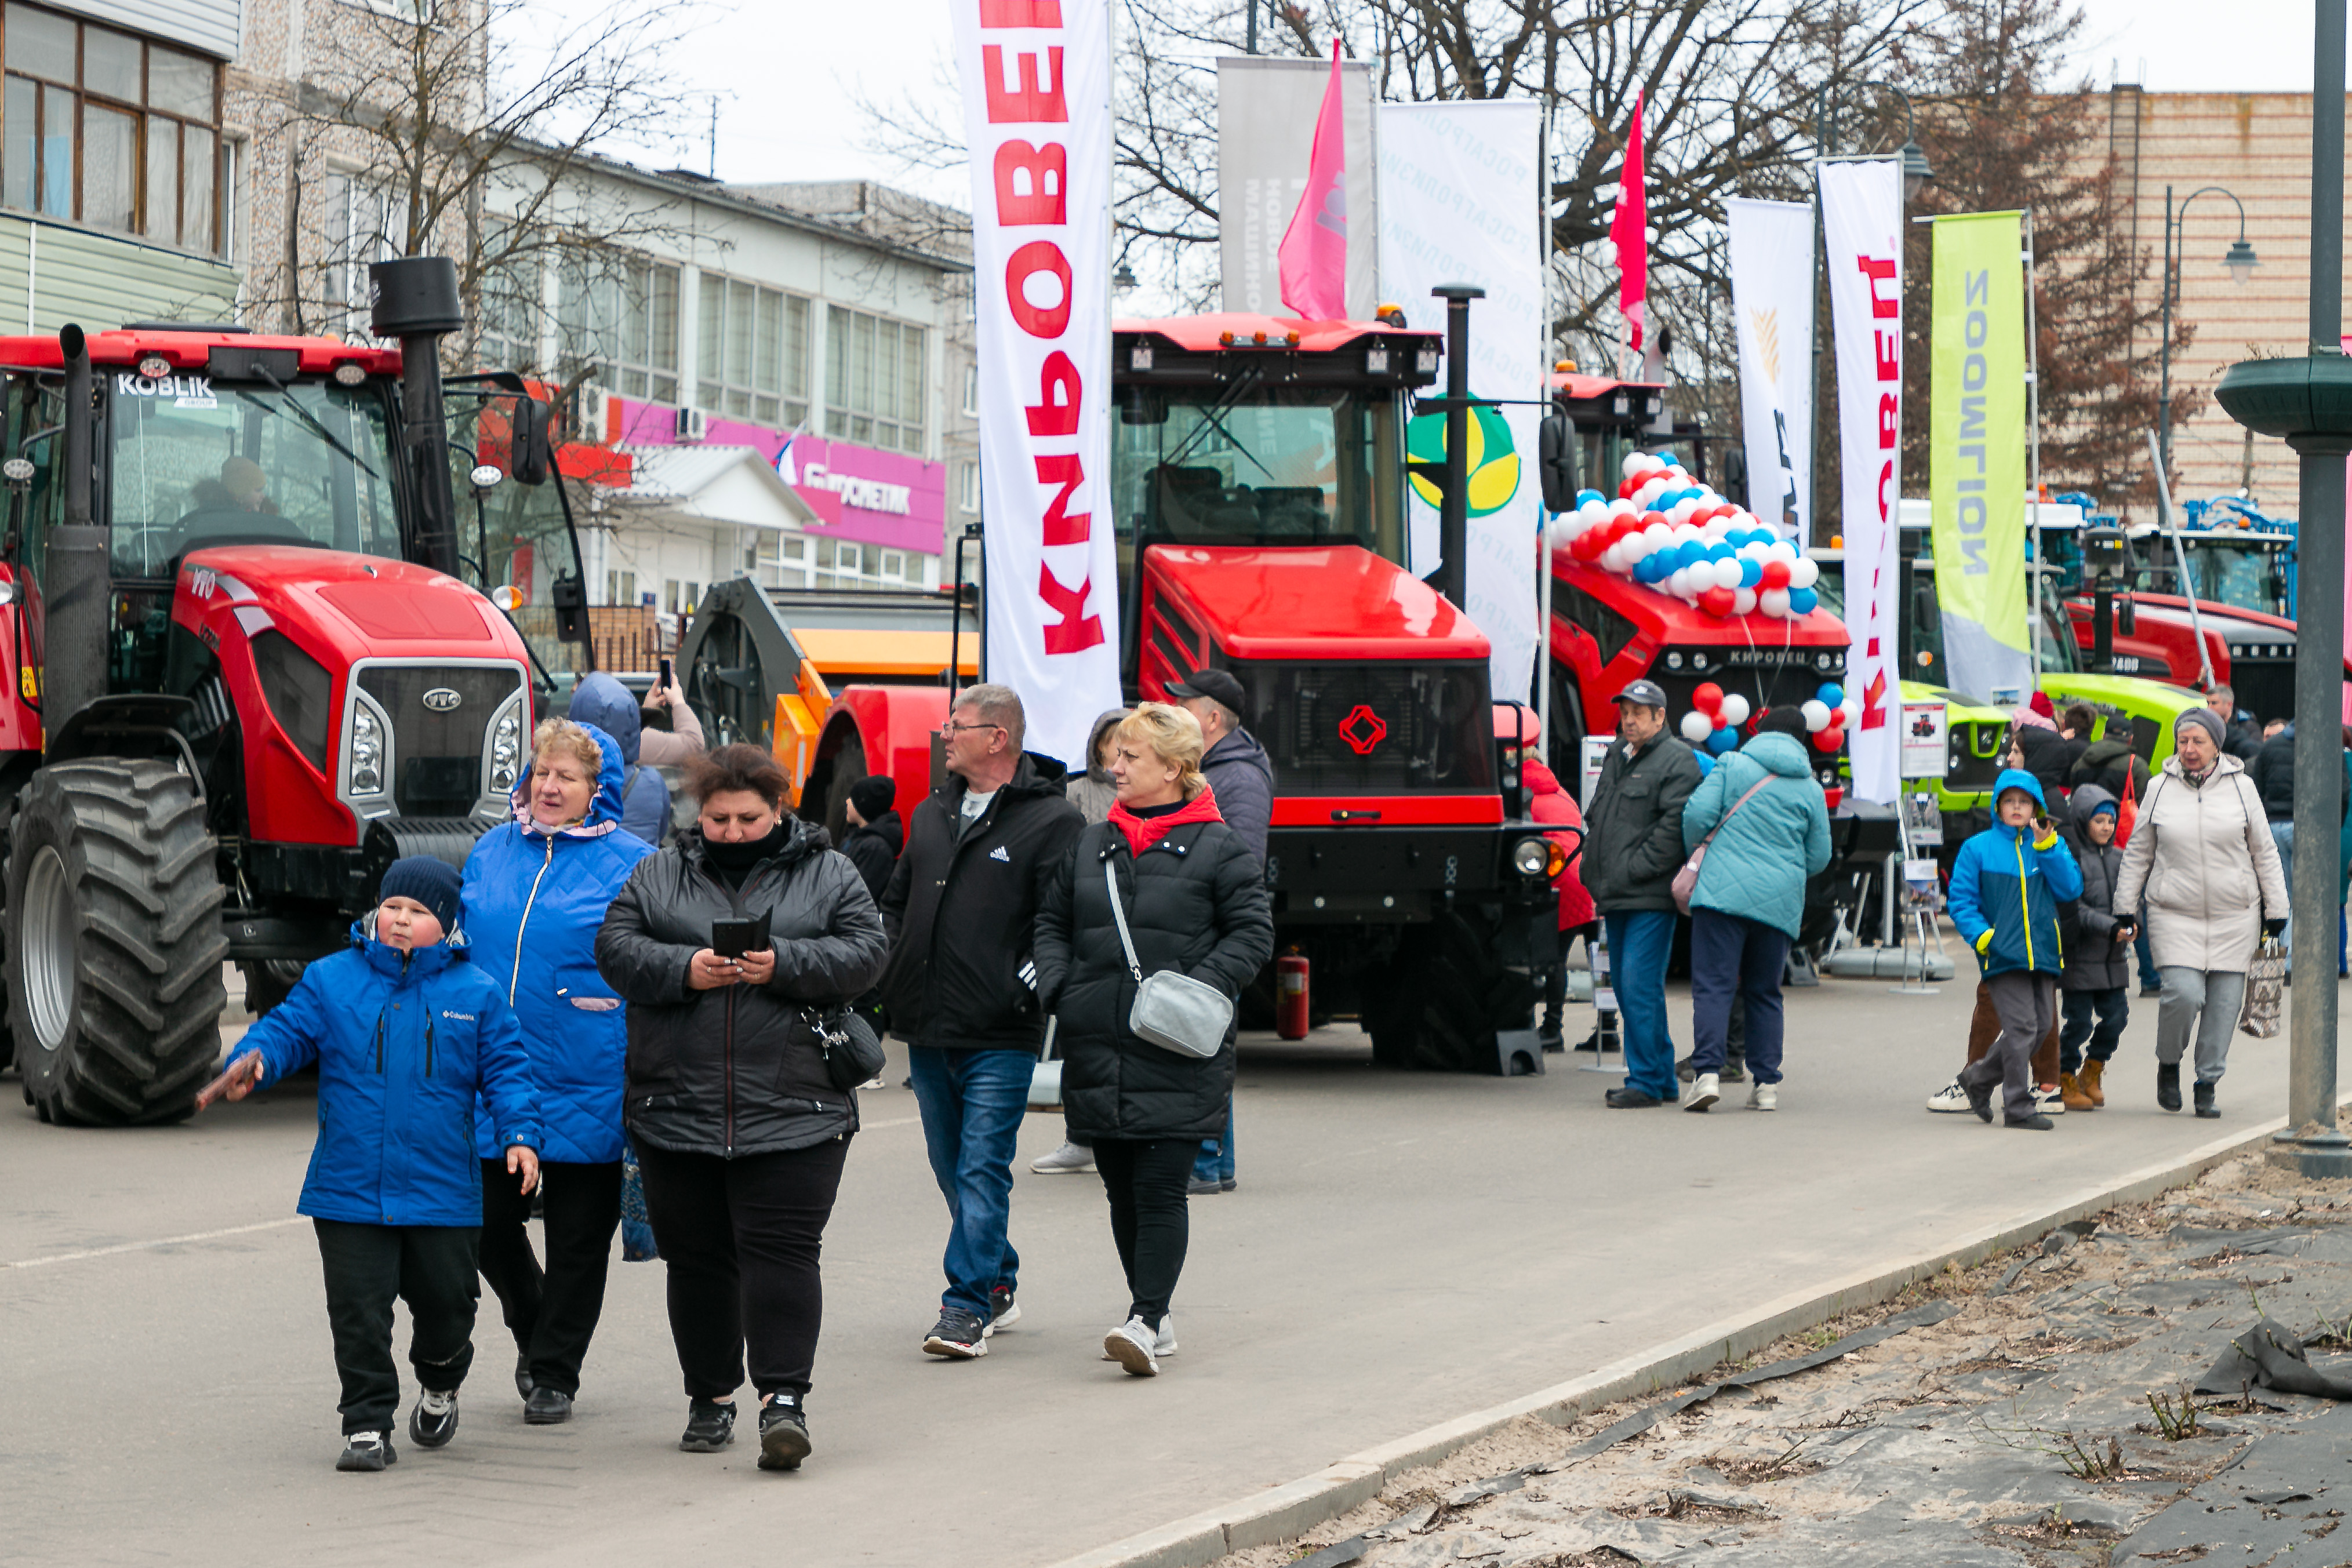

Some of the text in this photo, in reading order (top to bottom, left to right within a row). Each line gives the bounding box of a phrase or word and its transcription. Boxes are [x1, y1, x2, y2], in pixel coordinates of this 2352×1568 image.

[1266, 178, 1282, 272] НОВОЕ
[118, 373, 216, 397] KOBLIK
[1731, 650, 1805, 666] КИРОВЕЦ
